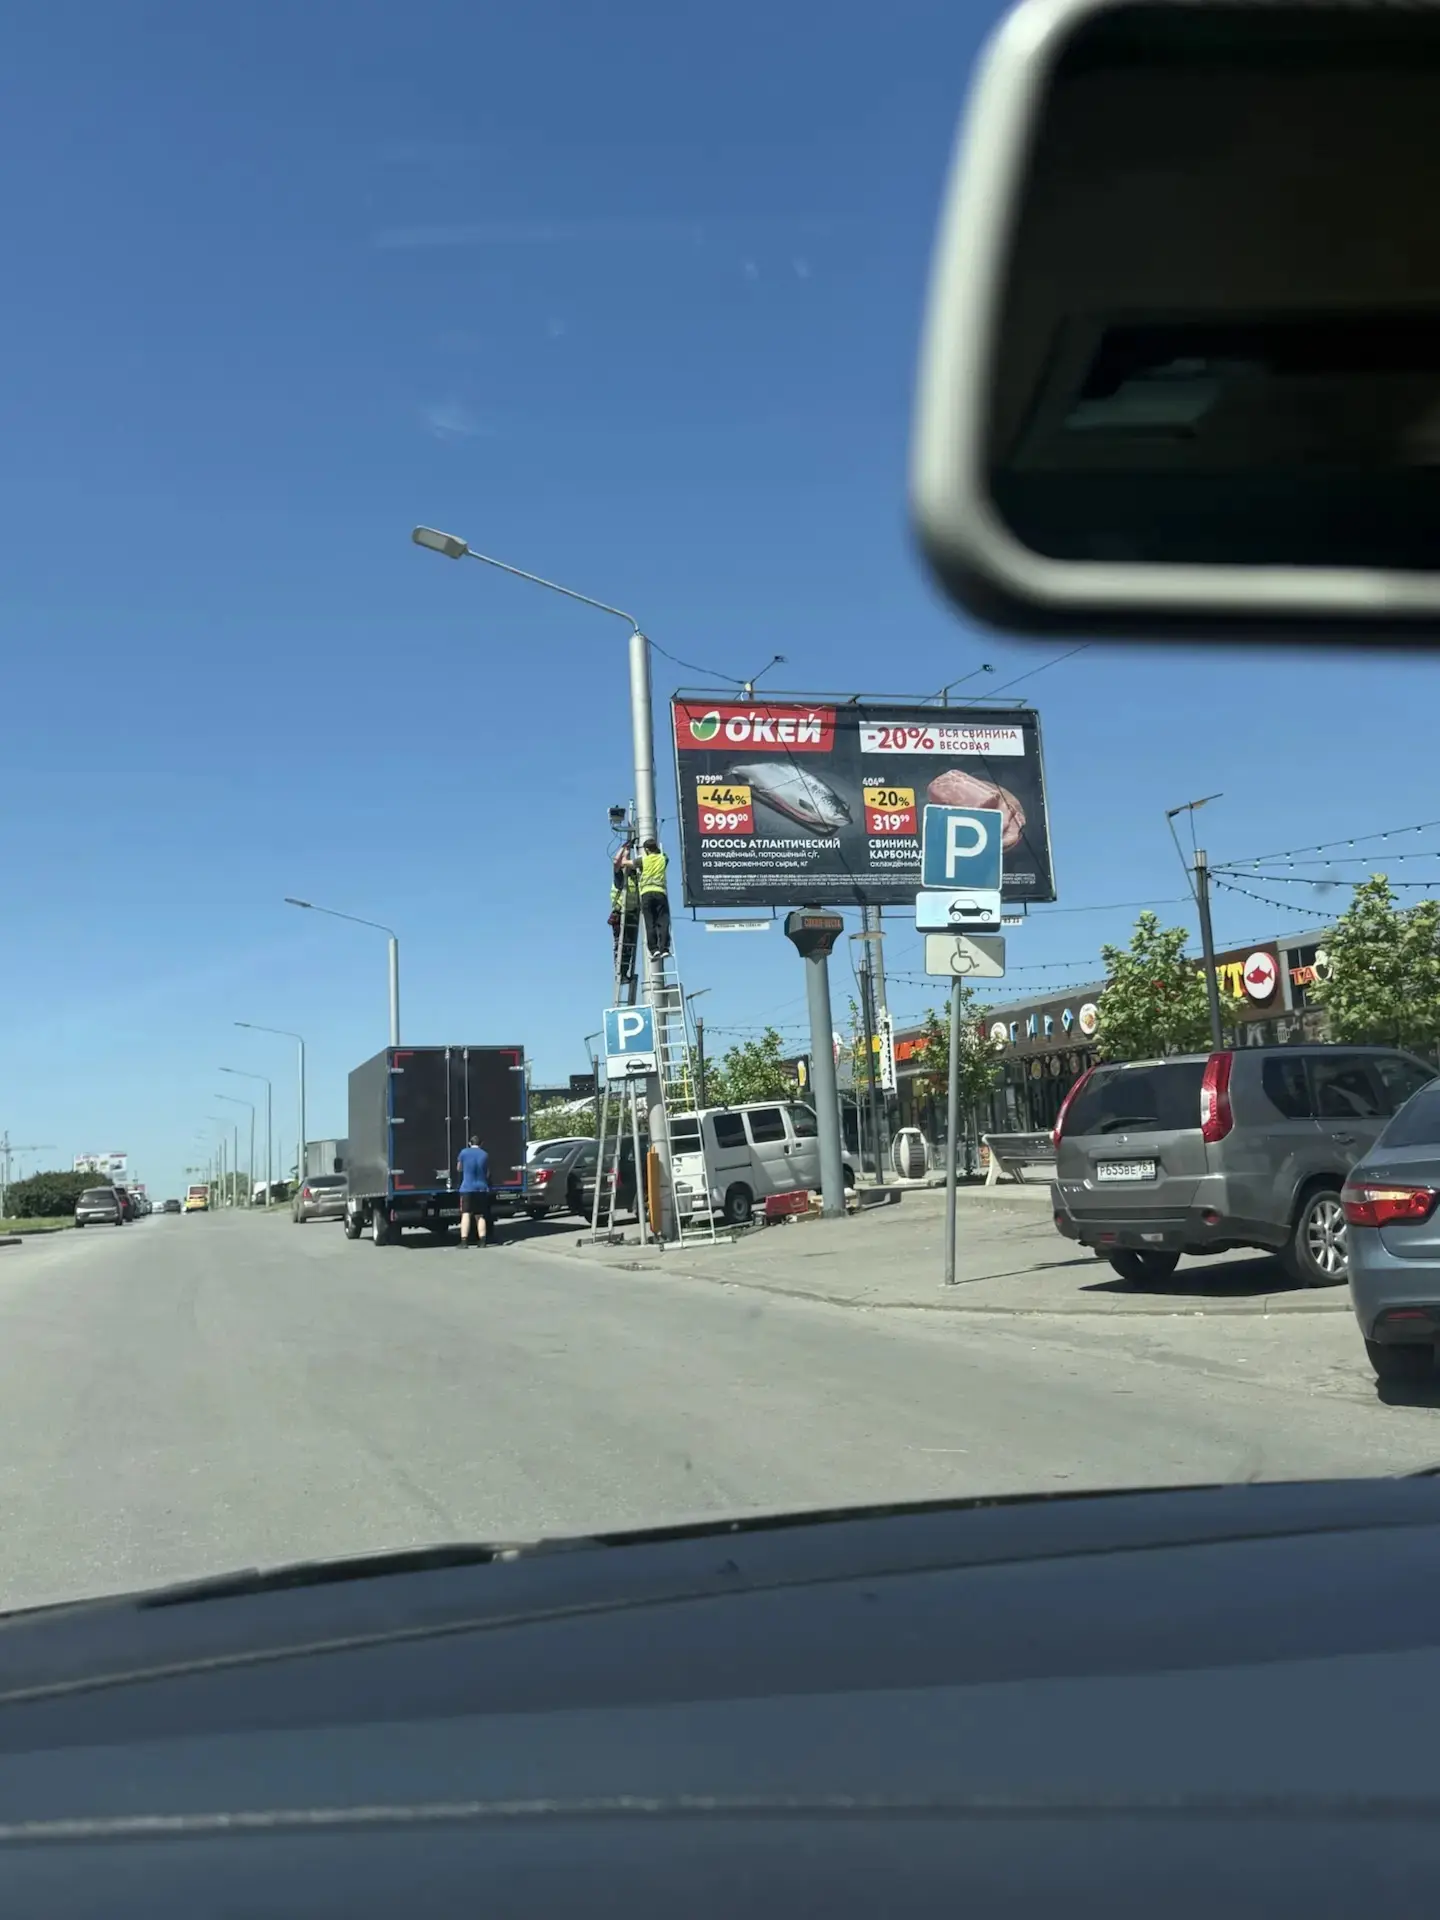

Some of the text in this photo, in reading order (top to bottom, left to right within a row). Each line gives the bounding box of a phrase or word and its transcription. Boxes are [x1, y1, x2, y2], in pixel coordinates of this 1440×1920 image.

[867, 726, 1018, 750] -20% ВСЯ СВИНИНА
[939, 741, 990, 751] ВЕСОВАЯ
[702, 788, 747, 806] -44%
[870, 790, 910, 807] -20%
[701, 837, 841, 849] ЛОСОСЬ АТЛАНТИЧЕСКИЙ
[868, 839, 919, 848] СВИНИНА
[713, 861, 774, 869] замороженного
